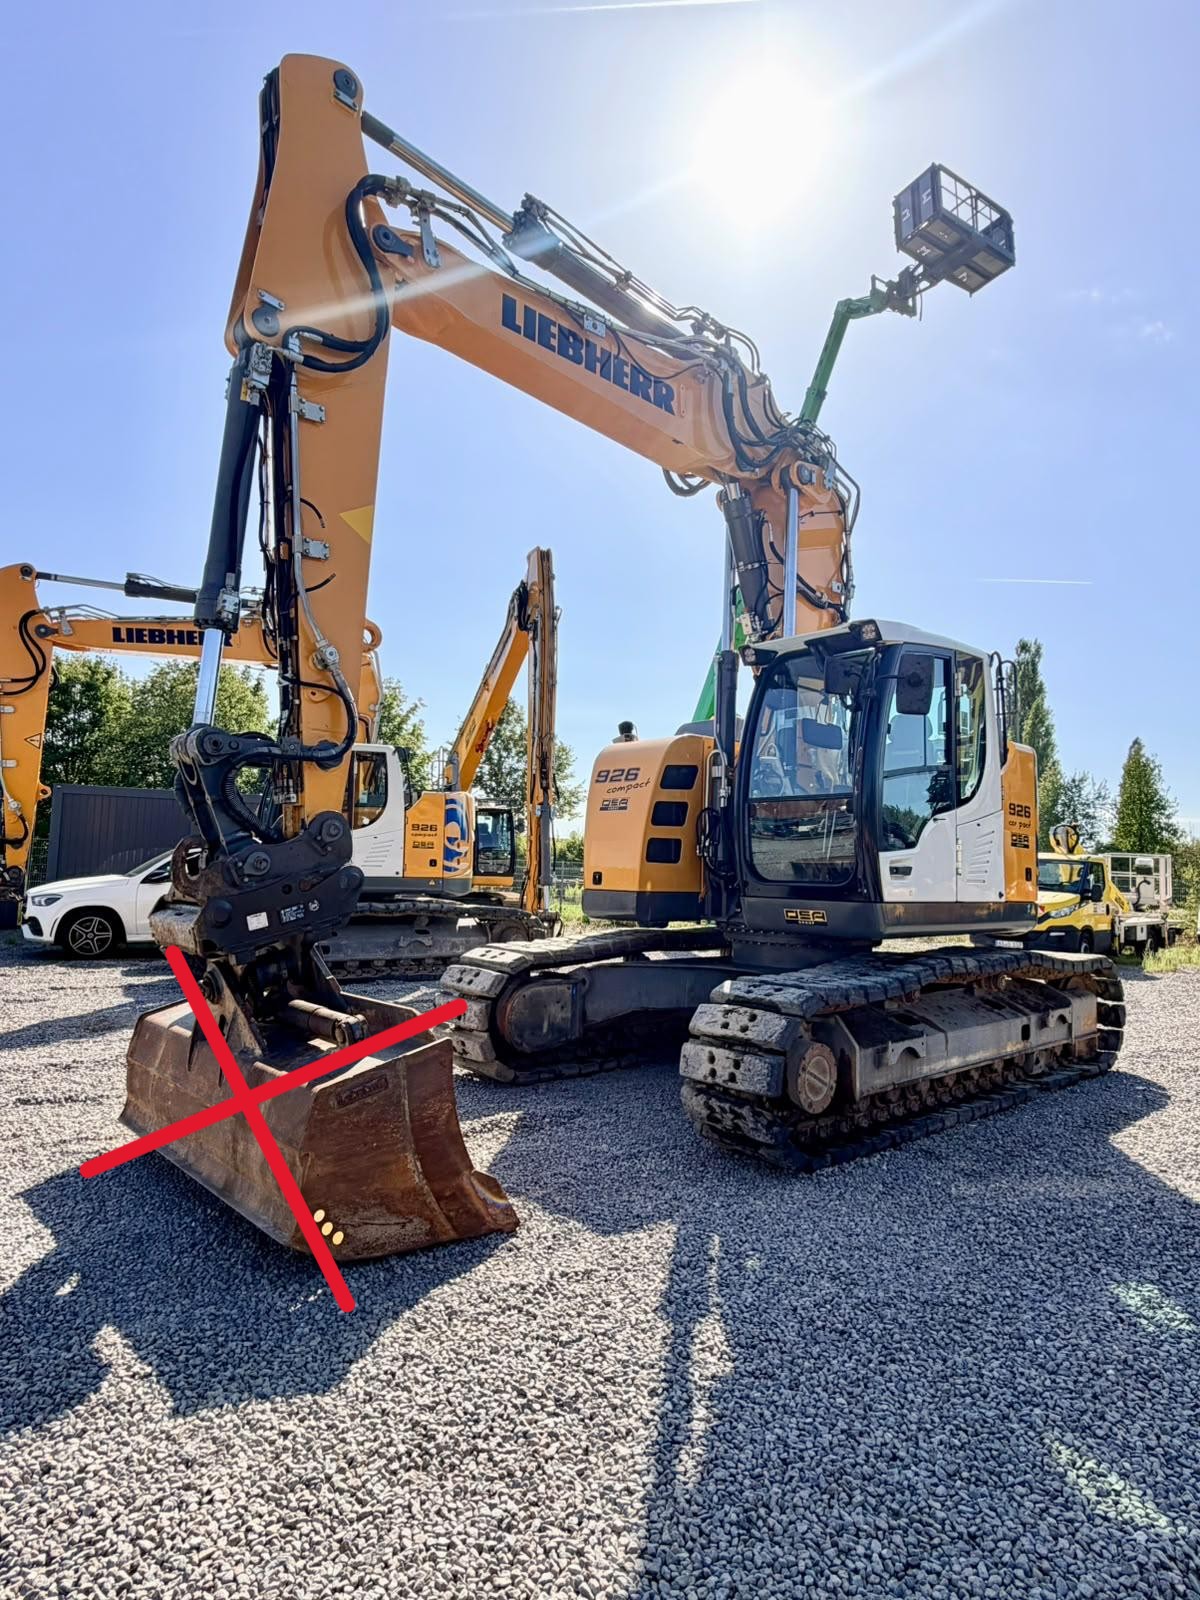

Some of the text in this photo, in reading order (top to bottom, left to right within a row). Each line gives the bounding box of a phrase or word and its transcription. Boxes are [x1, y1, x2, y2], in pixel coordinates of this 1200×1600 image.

[502, 293, 675, 415] LIEBHERR
[595, 767, 641, 783] 926
[606, 776, 651, 794] compact
[1008, 803, 1031, 818] 926
[411, 823, 437, 831] 926
